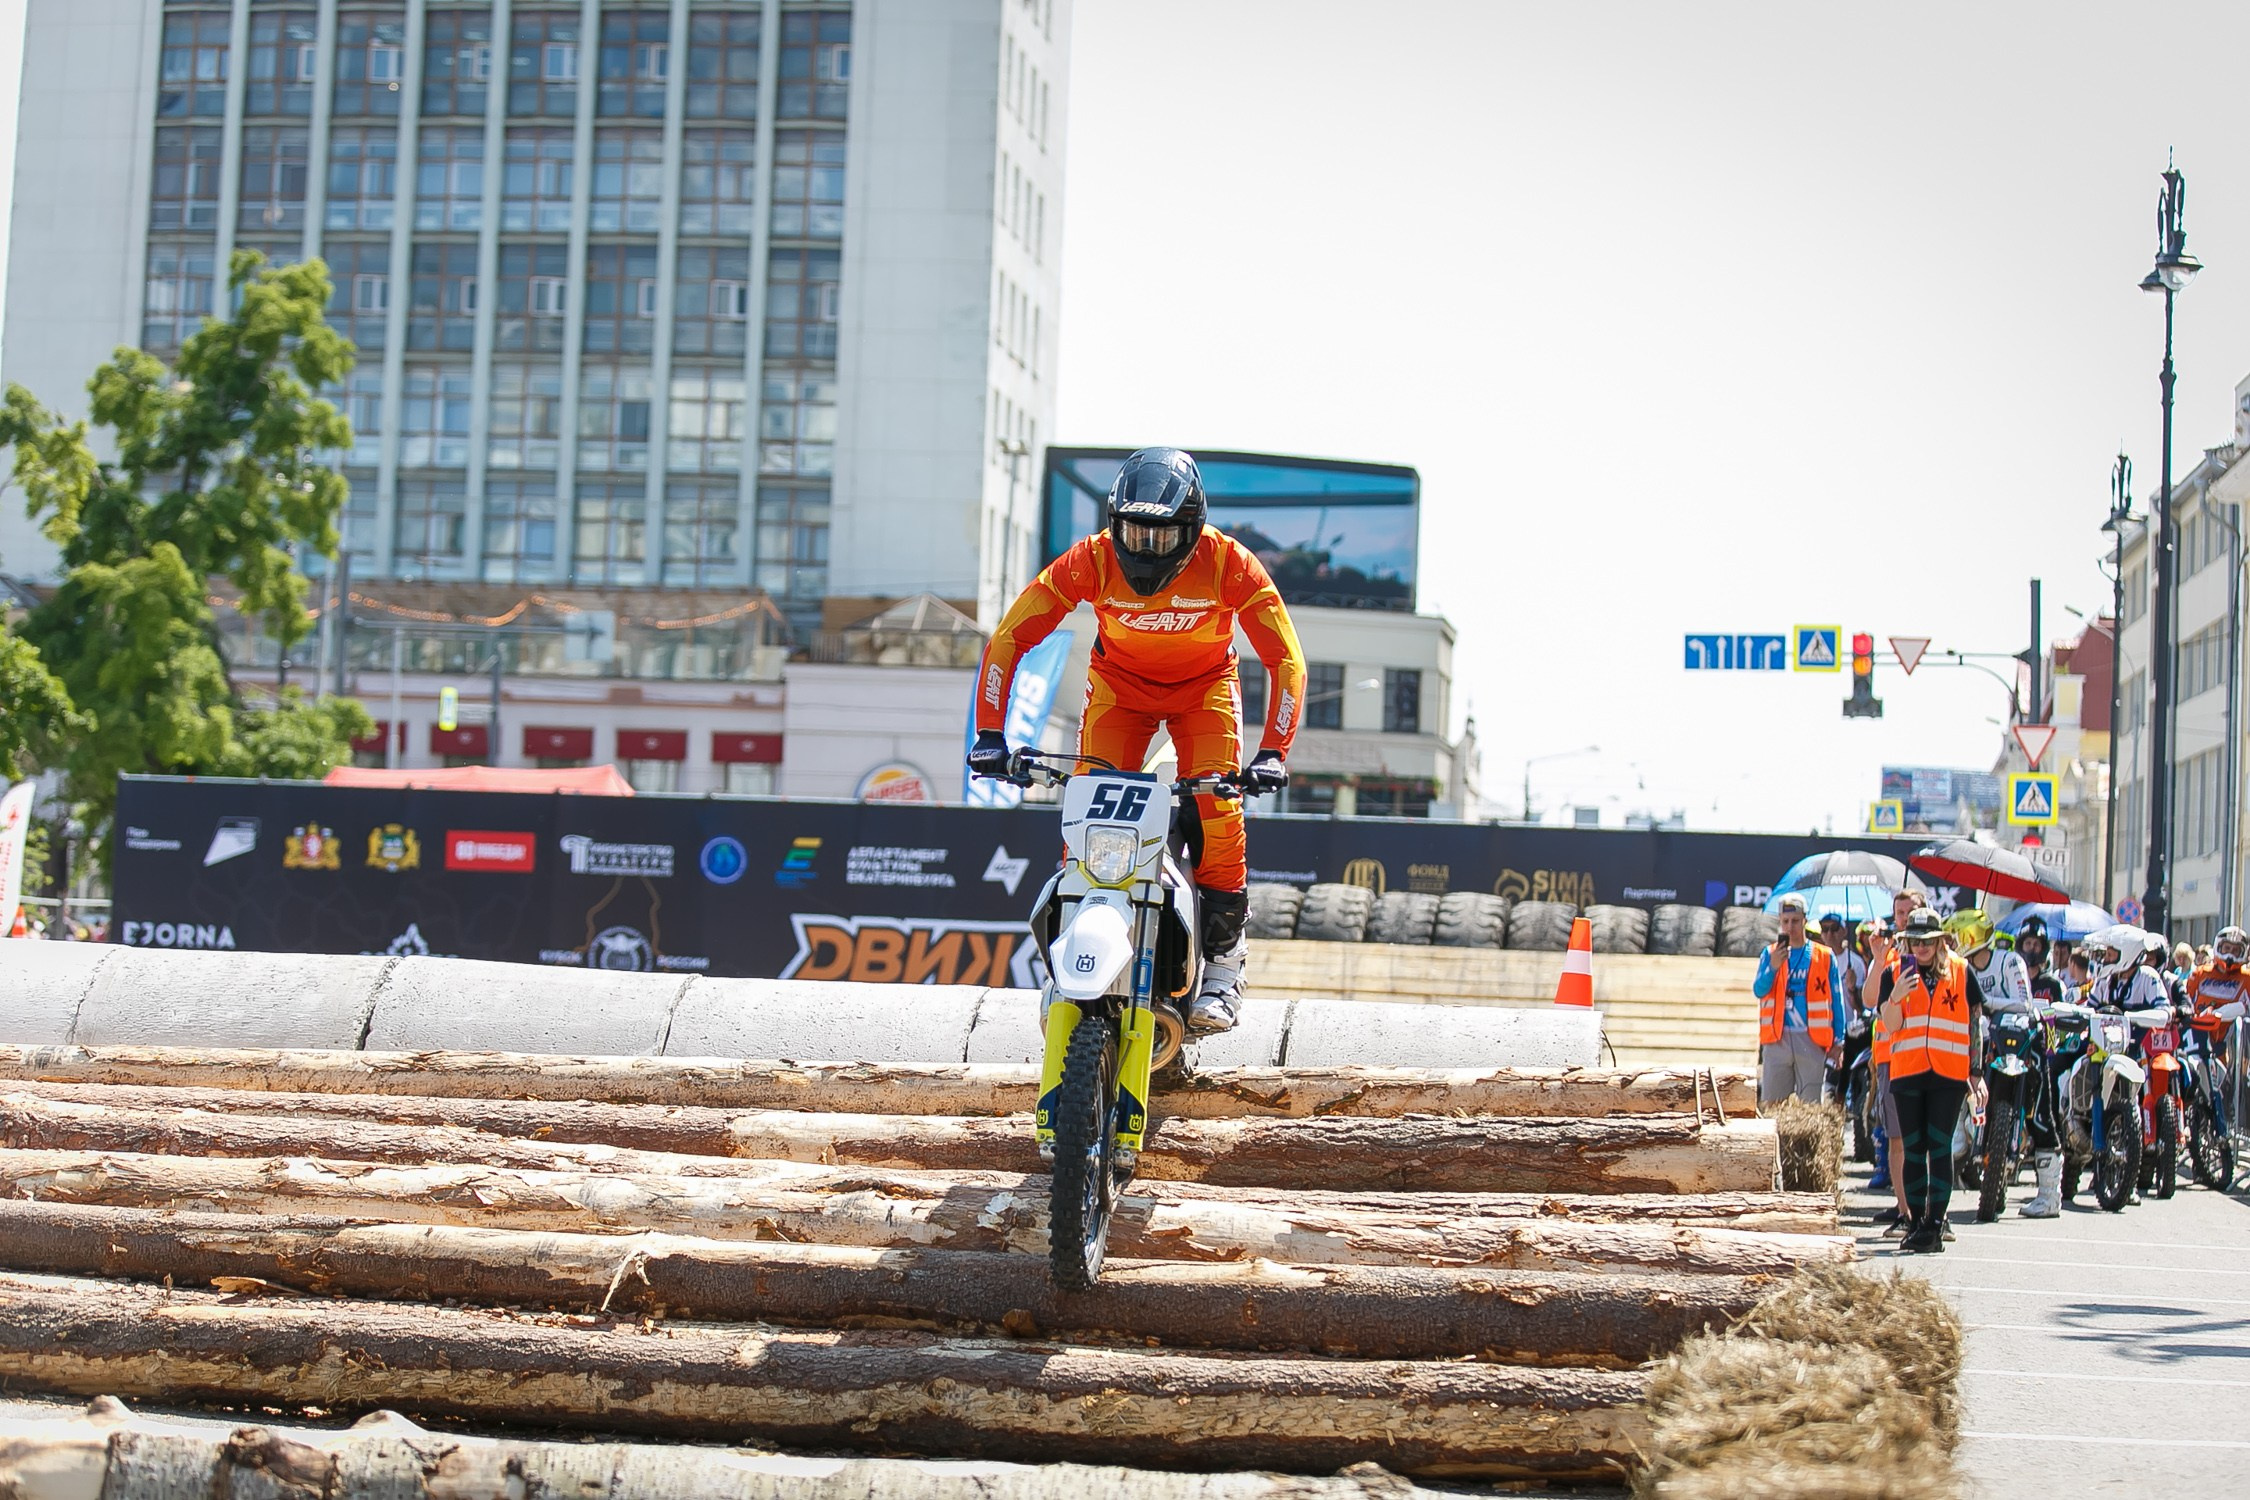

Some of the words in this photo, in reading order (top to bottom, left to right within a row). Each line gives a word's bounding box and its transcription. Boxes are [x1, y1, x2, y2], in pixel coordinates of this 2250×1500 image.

[1119, 501, 1173, 516] LEATT
[1118, 611, 1208, 631] LEATT
[985, 663, 1004, 710] LEATT
[1274, 688, 1296, 736] LEATT
[972, 750, 998, 759] LEATT
[1086, 783, 1153, 822] 56
[1533, 869, 1595, 891] SIMA
